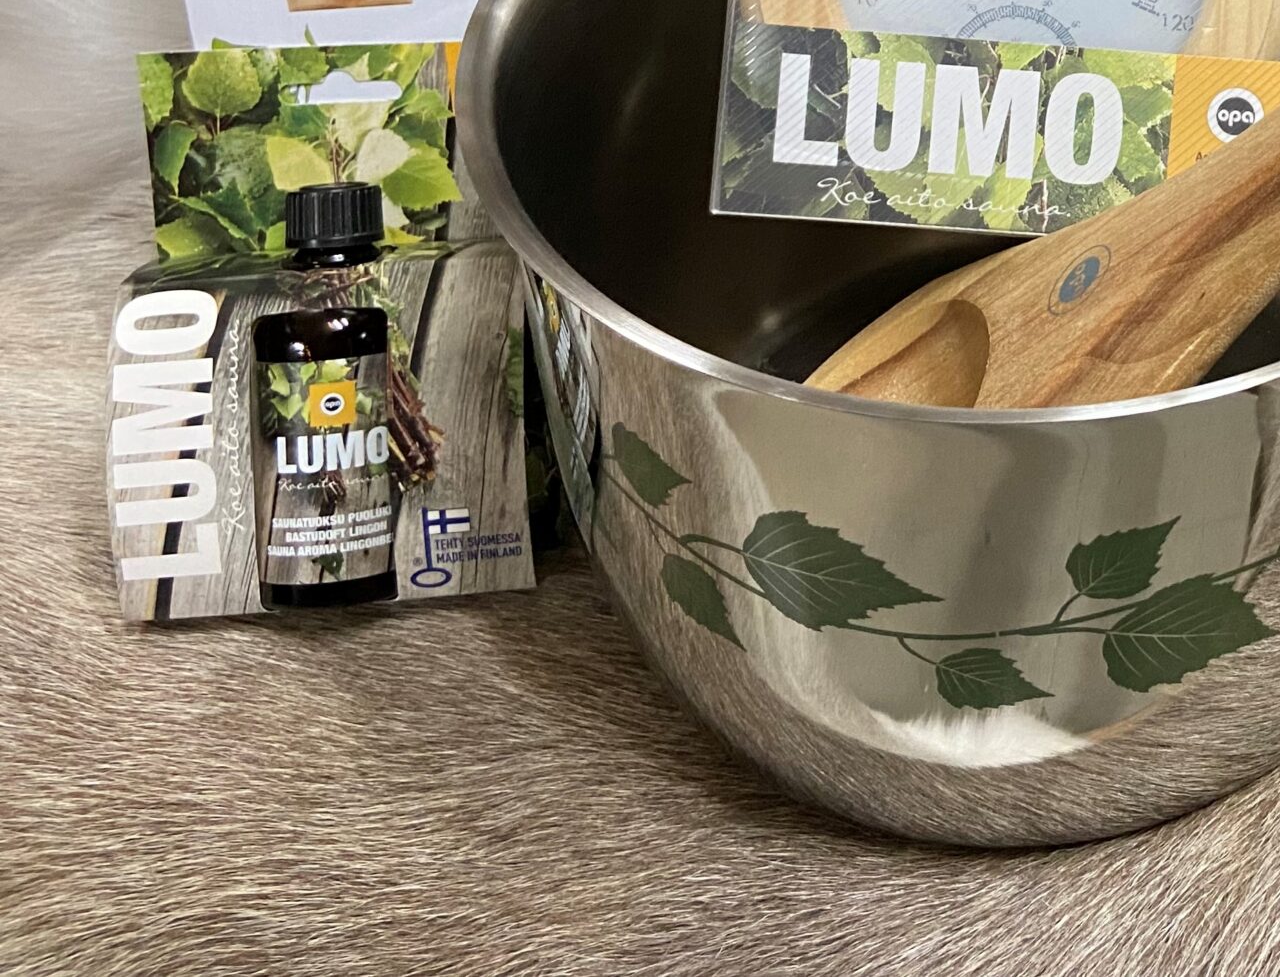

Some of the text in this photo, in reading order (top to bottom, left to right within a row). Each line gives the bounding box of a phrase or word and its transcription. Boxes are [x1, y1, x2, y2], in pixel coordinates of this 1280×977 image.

[772, 52, 1124, 185] LUMO
[1217, 109, 1254, 127] opa
[816, 177, 882, 206] Koe
[886, 189, 950, 209] aito
[112, 289, 223, 582] LUMO
[276, 426, 390, 475] LUMO
[272, 513, 346, 529] SAUNATUOKSU
[285, 521, 388, 543] BASTUDOFT LINGON
[267, 533, 394, 557] SAUNA AROMA LINGONBE
[435, 532, 522, 551] TEHTY SUOMESSA
[436, 545, 522, 564] MADE IN FINLAND
